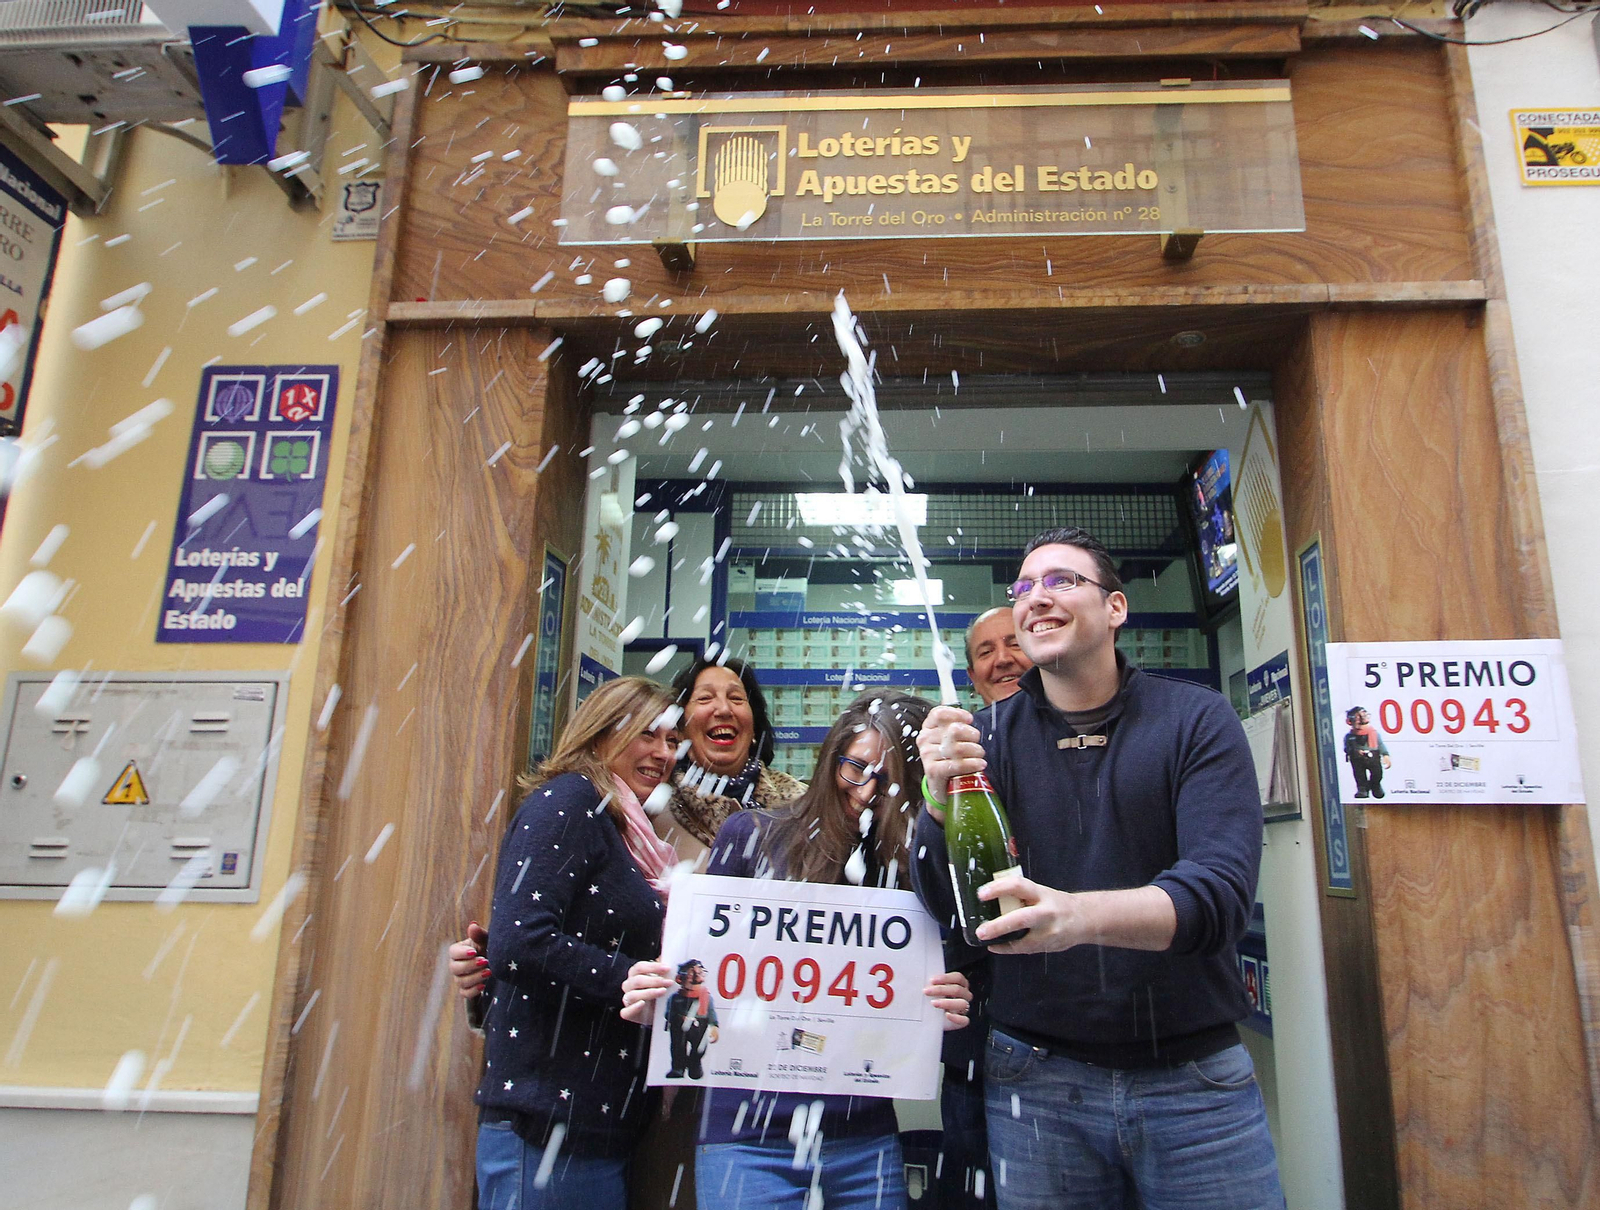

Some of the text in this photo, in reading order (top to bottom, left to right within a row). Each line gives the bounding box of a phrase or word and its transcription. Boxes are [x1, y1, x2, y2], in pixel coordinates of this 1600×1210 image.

[1518, 112, 1600, 122] CONECTADA
[798, 128, 972, 163] Loterías y
[796, 162, 1159, 203] Apuestas del Estado
[802, 205, 1161, 227] La Torre del Oro Administración nº 28
[174, 547, 280, 572] Loterías y
[168, 577, 305, 602] Apuestas del
[163, 609, 237, 630] Estado
[832, 616, 868, 625] Nacional
[855, 673, 891, 682] Nacional
[1396, 660, 1536, 688] PREMIO
[1379, 698, 1531, 735] 00943
[749, 906, 912, 950] PREMIO
[717, 953, 895, 1009] 00943
[778, 1064, 789, 1072] DE
[789, 1064, 828, 1074] DICIEMBRE
